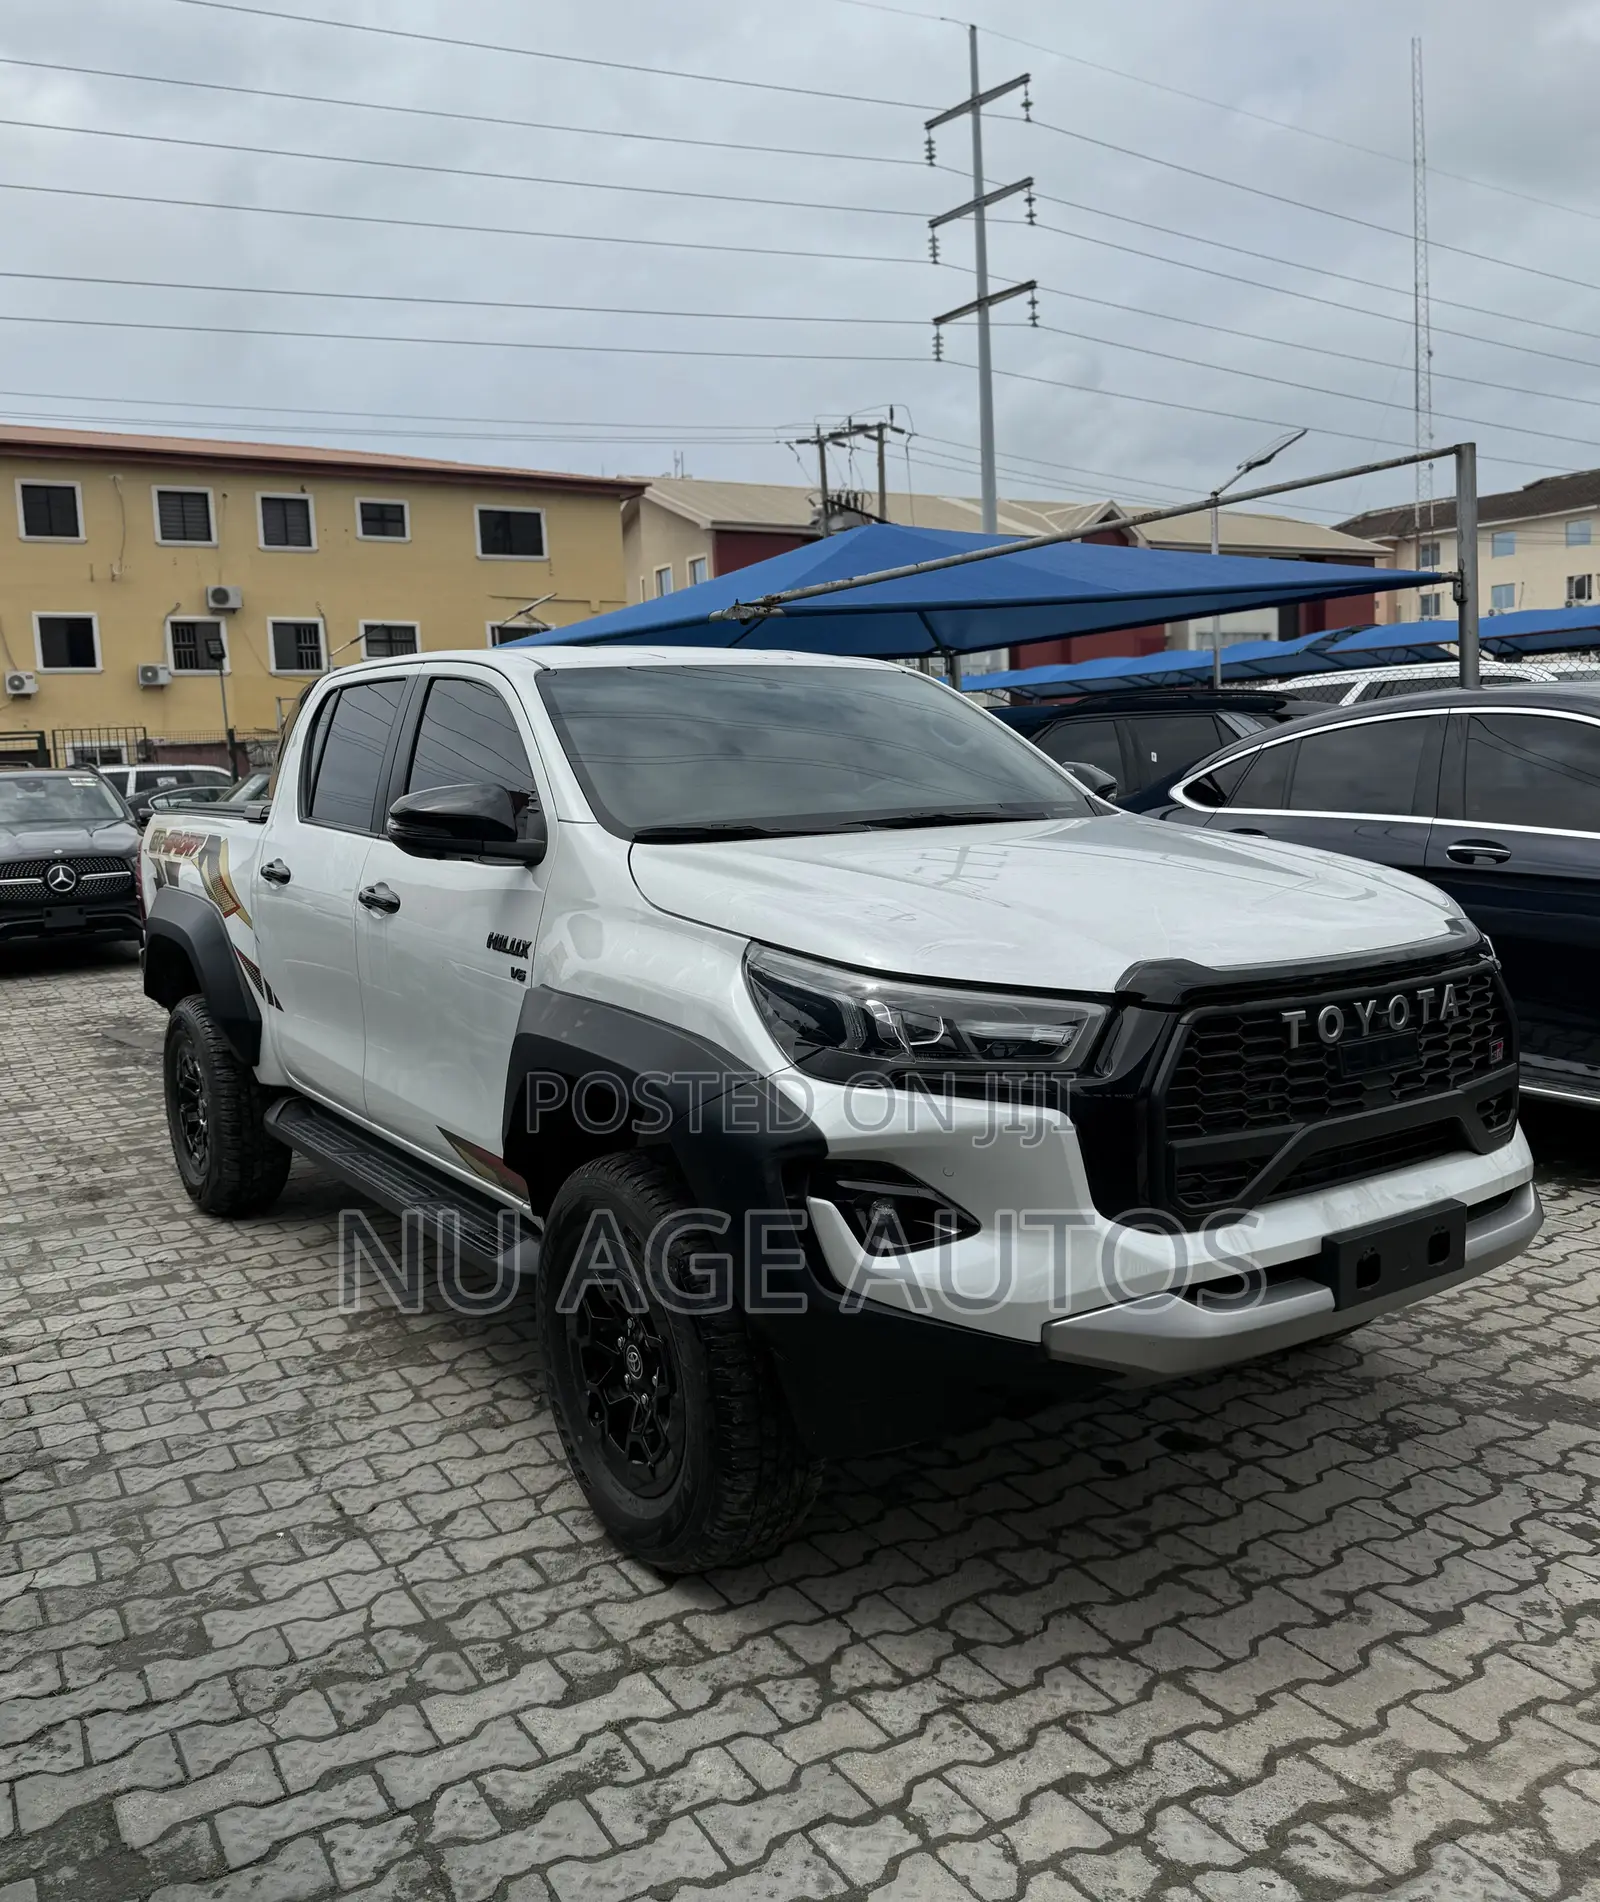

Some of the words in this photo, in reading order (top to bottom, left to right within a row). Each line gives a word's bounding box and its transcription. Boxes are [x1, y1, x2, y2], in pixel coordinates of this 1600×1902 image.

[486, 932, 532, 959] HILUX
[510, 966, 527, 982] V6
[1281, 984, 1459, 1049] TOYOTA
